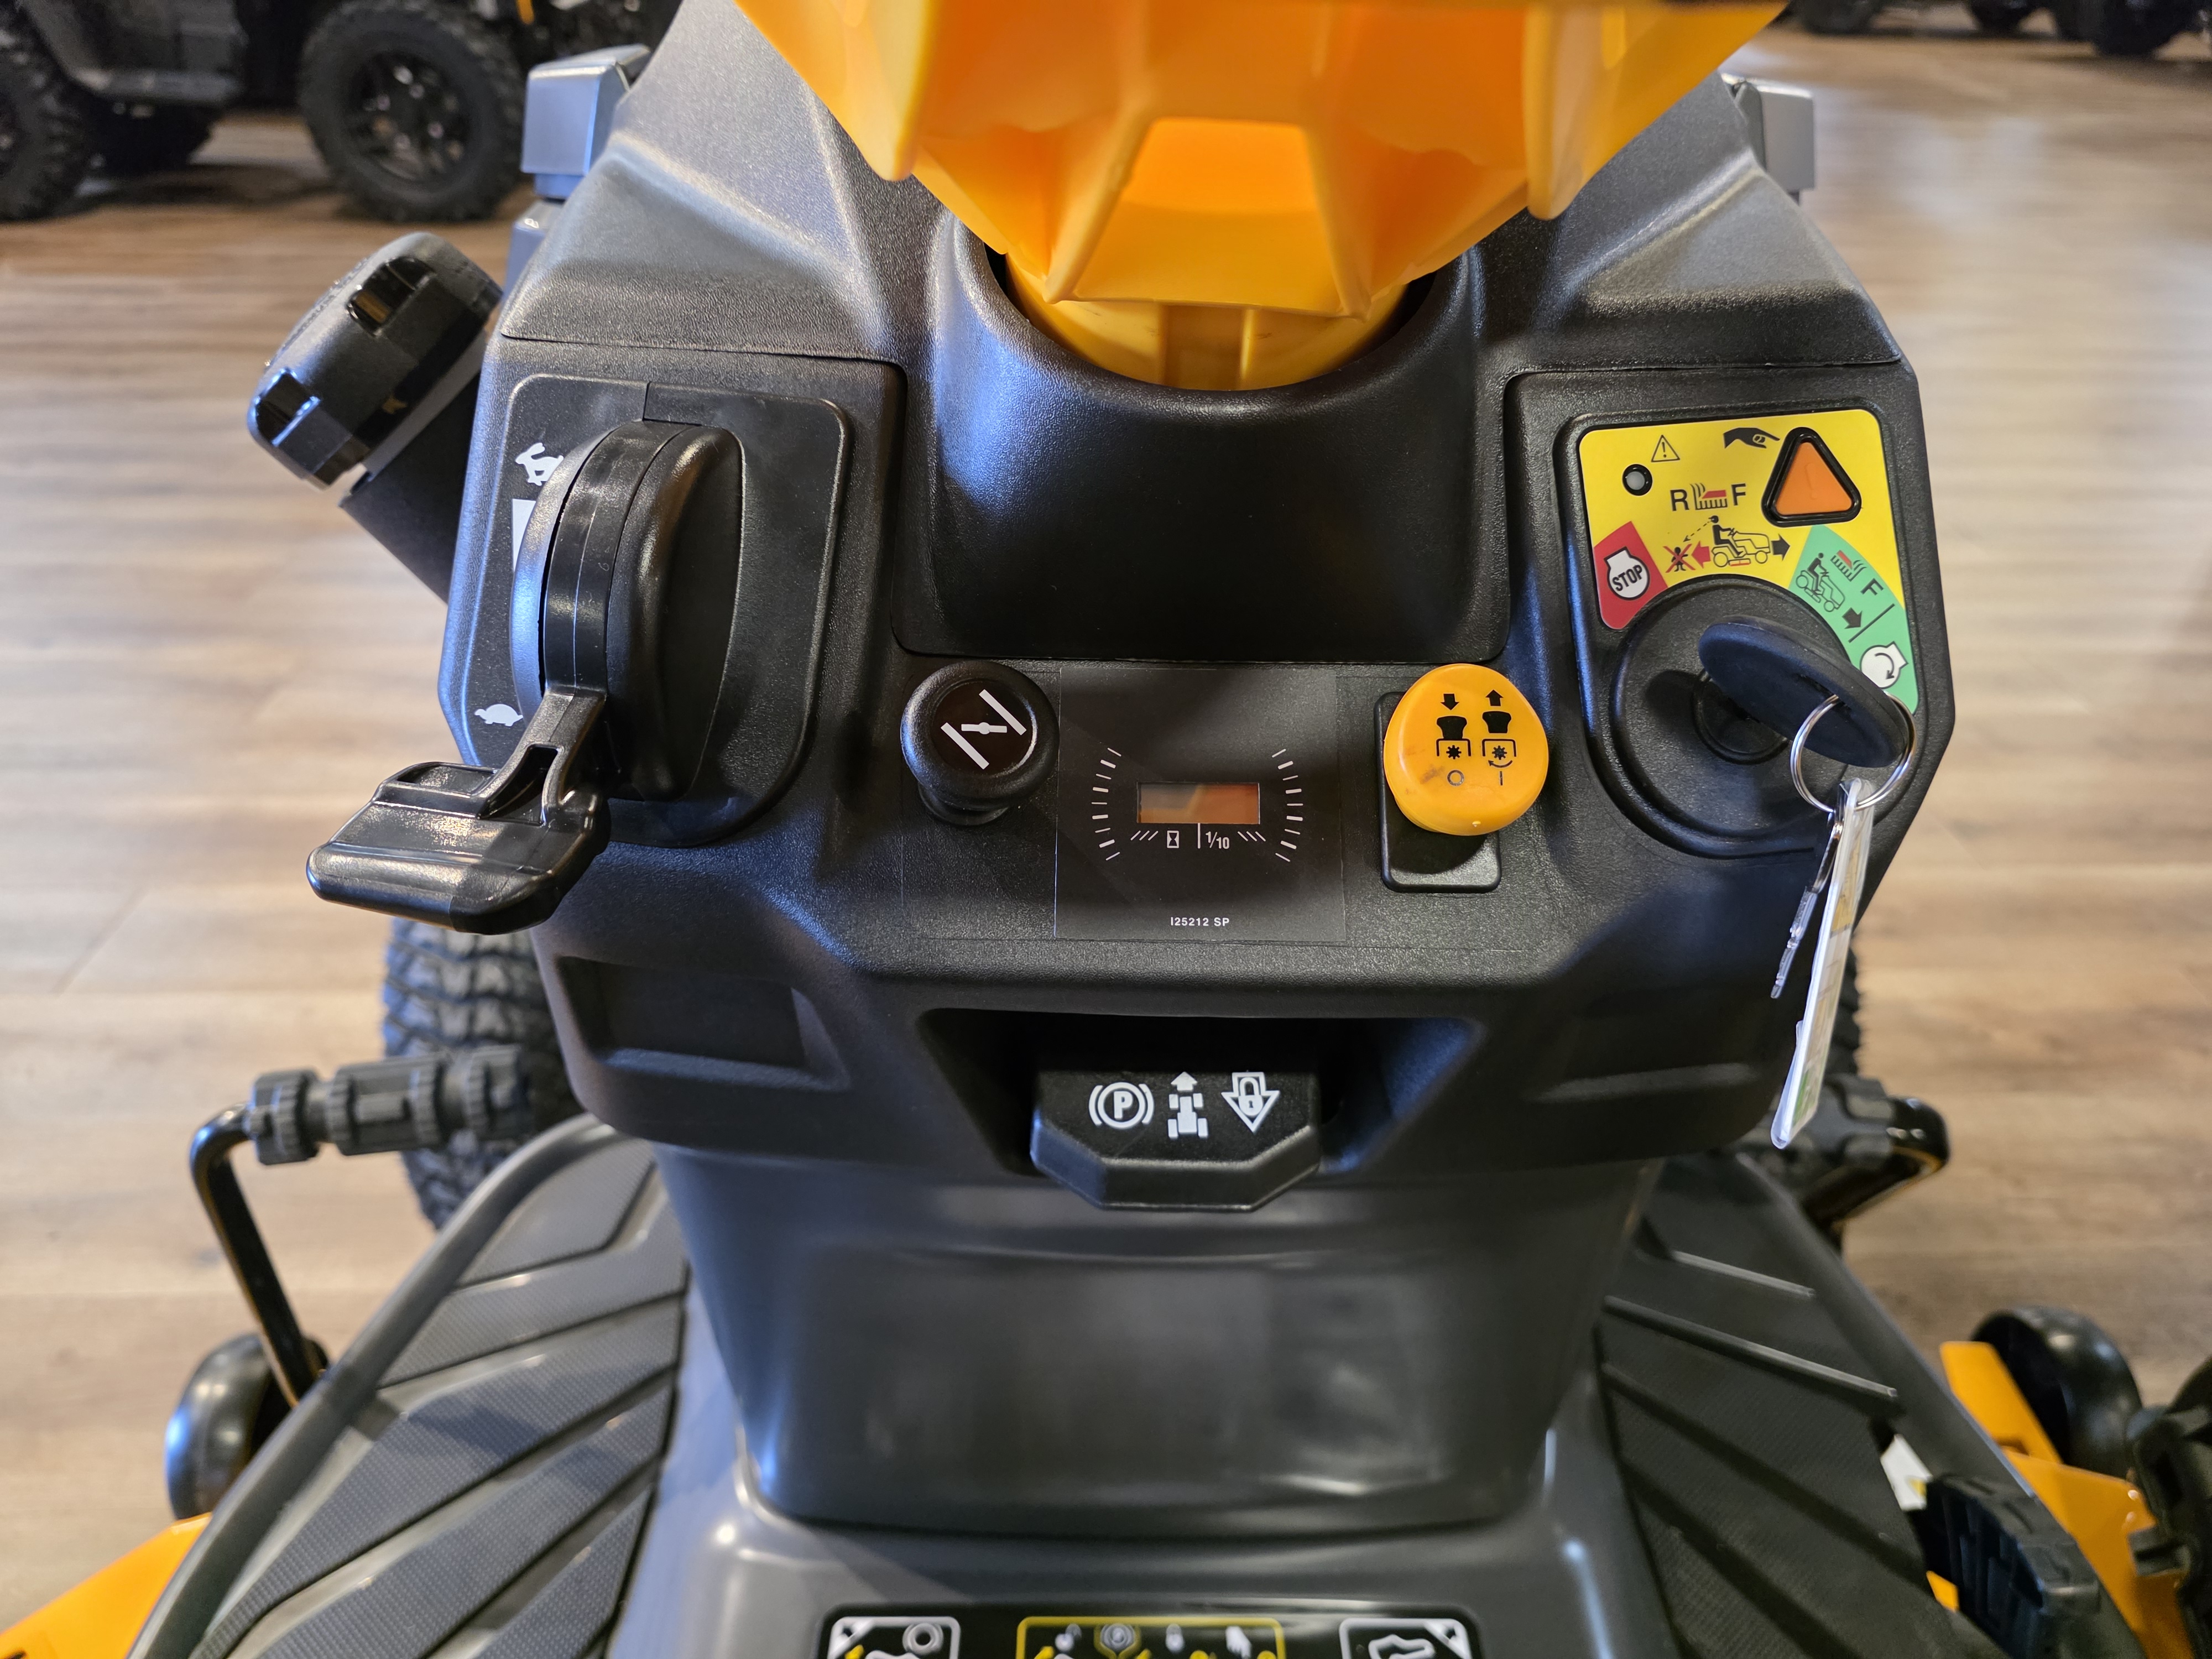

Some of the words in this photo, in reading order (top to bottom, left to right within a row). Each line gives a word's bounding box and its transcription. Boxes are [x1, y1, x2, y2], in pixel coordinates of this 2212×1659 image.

[1670, 489, 1689, 511] R
[1731, 483, 1746, 505] F
[1612, 564, 1642, 592] STOP
[1860, 578, 1884, 596] F
[1214, 917, 1230, 927] SP
[1113, 1091, 1133, 1119] P
